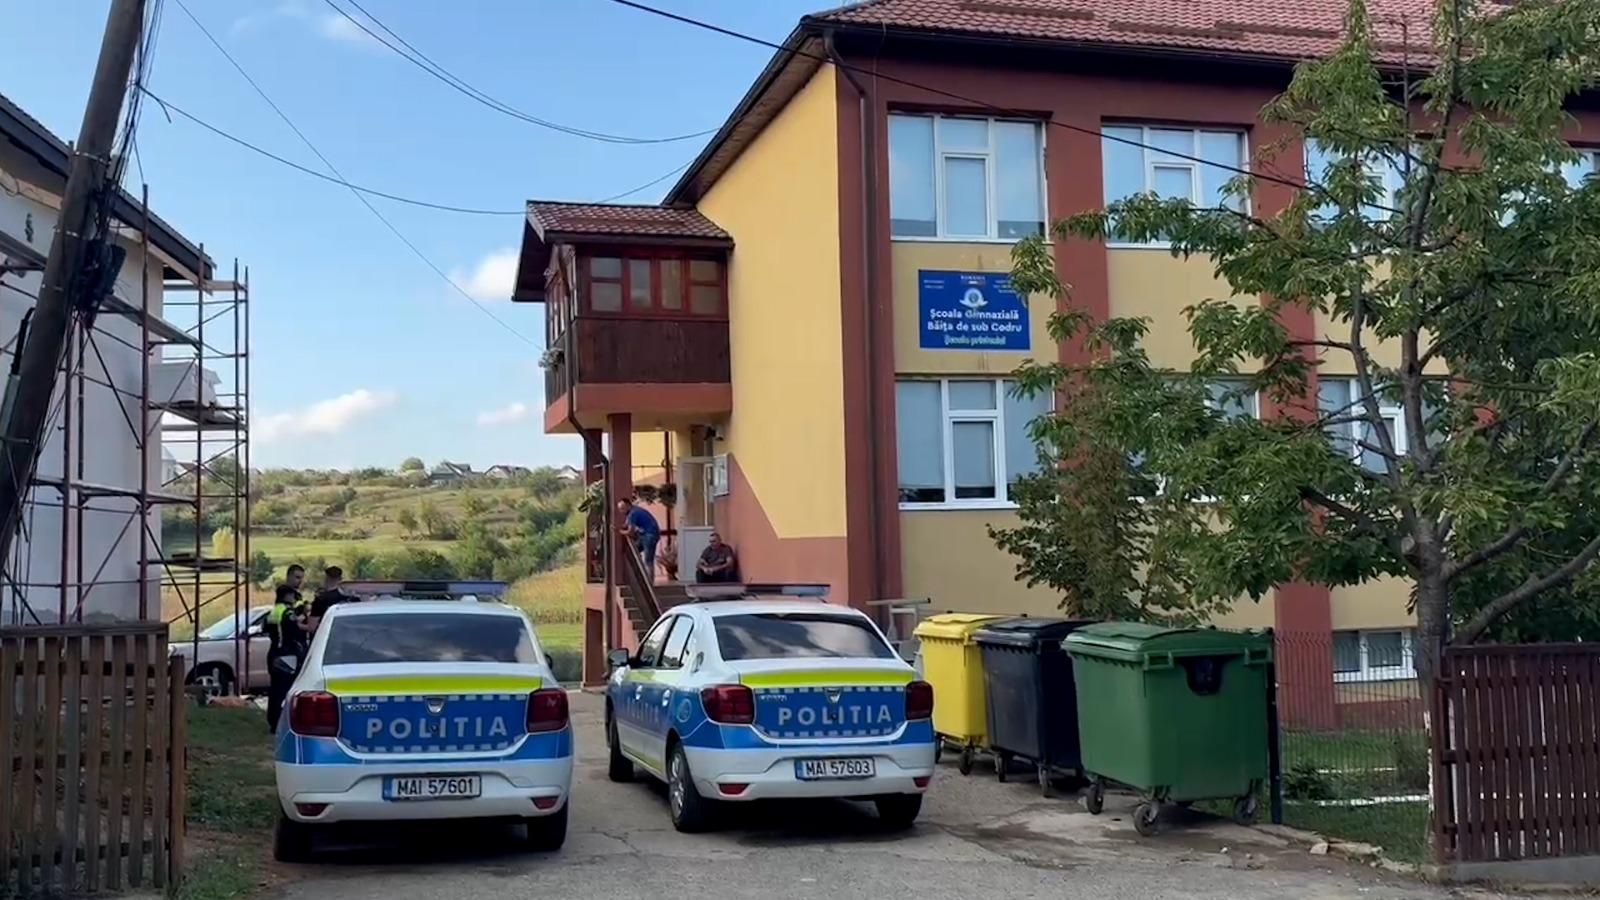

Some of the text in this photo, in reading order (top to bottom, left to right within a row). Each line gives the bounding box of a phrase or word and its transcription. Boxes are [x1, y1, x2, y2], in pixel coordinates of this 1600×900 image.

[955, 322, 968, 331] de
[971, 322, 989, 332] sub
[990, 322, 1022, 332] Codru
[778, 705, 892, 726] POLITIA
[366, 716, 508, 739] POLITIA
[805, 760, 871, 775] MAI 57603
[397, 778, 473, 796] MAI 57601
